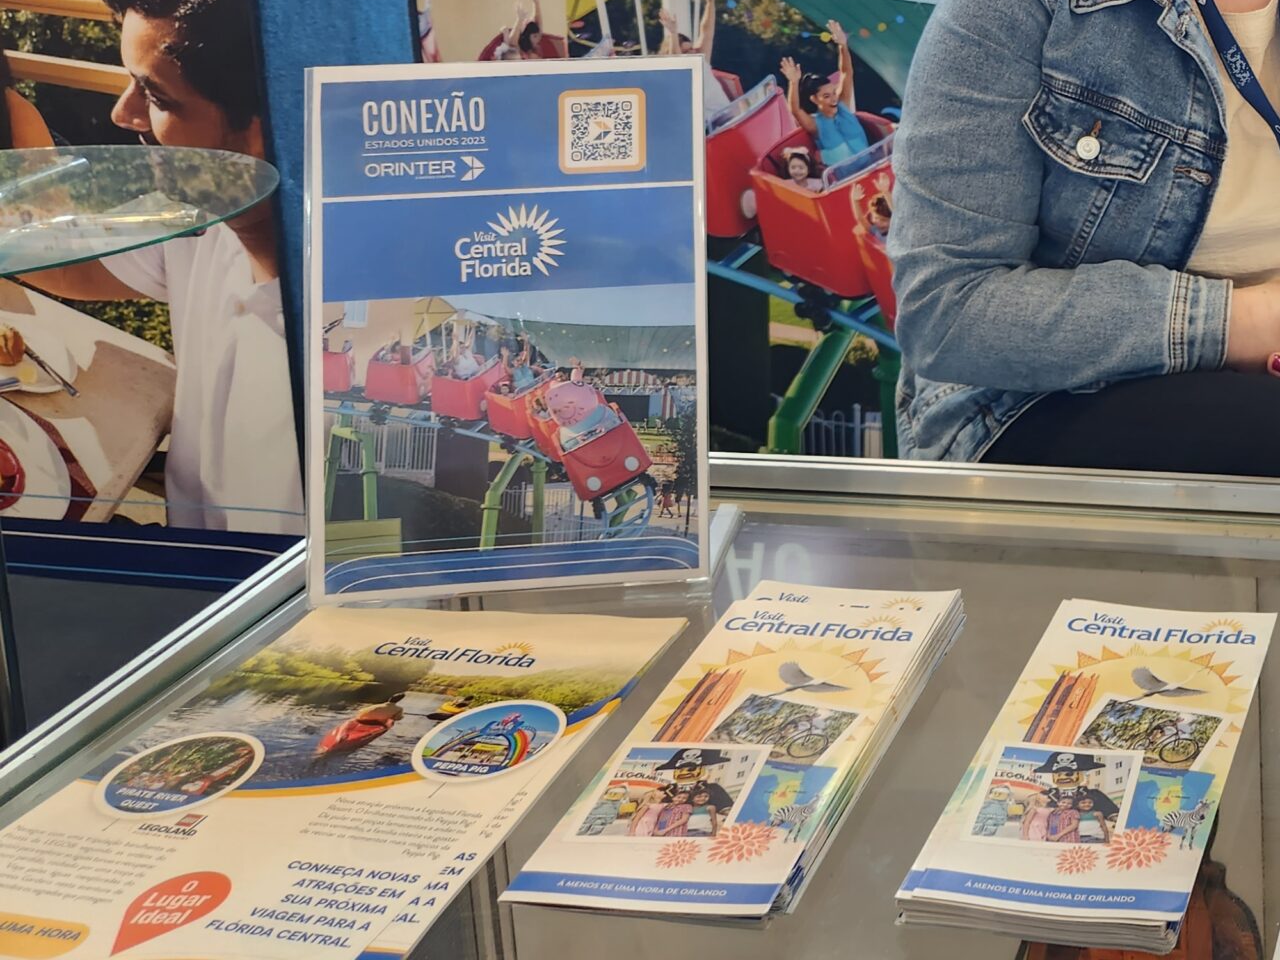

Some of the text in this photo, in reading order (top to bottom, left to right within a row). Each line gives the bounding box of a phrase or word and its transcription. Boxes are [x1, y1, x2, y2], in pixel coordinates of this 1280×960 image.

[362, 91, 485, 136] CONEXÃO
[365, 136, 486, 149] ESTADOS UNIDOS 2023
[364, 160, 456, 178] ORINTER
[474, 231, 497, 242] Visit
[454, 237, 527, 260] Central
[461, 257, 532, 283] Florida
[777, 592, 811, 604] Visit
[753, 610, 785, 621] Visit
[1093, 612, 1125, 625] Visit
[724, 617, 913, 642] Central Florida
[1067, 618, 1257, 645] Central Florida
[403, 636, 433, 646] Visit
[374, 642, 536, 668] Central Florida
[432, 761, 489, 774] PEPPA PIG
[116, 788, 188, 802] PIRATE RIVER
[120, 799, 159, 810] QUEST
[138, 823, 198, 837] LEGOLAND
[287, 860, 421, 884] CONHEÇA NOVAS
[182, 880, 199, 892] O
[292, 878, 406, 899] ATRAÇÕES EM
[565, 880, 599, 889] MENOS
[600, 882, 614, 890] DE
[614, 884, 635, 892] UMA
[637, 886, 664, 894] HORA
[666, 887, 679, 895] DE
[680, 889, 727, 897] ORLANDO
[973, 882, 1007, 893] MENOS
[1008, 886, 1022, 894] DE
[1022, 889, 1043, 897] UMA
[1045, 891, 1072, 900] HORA
[1074, 893, 1087, 901] DE
[1088, 895, 1136, 903] ORLANDO
[142, 892, 211, 909] Lugar
[281, 893, 388, 916] SUA PRÓXIMA
[130, 909, 192, 925] Ideal
[250, 907, 372, 932] VIAGEM PARA A
[0, 920, 82, 941] UMA HORA
[276, 929, 352, 948] CENTRAL.
